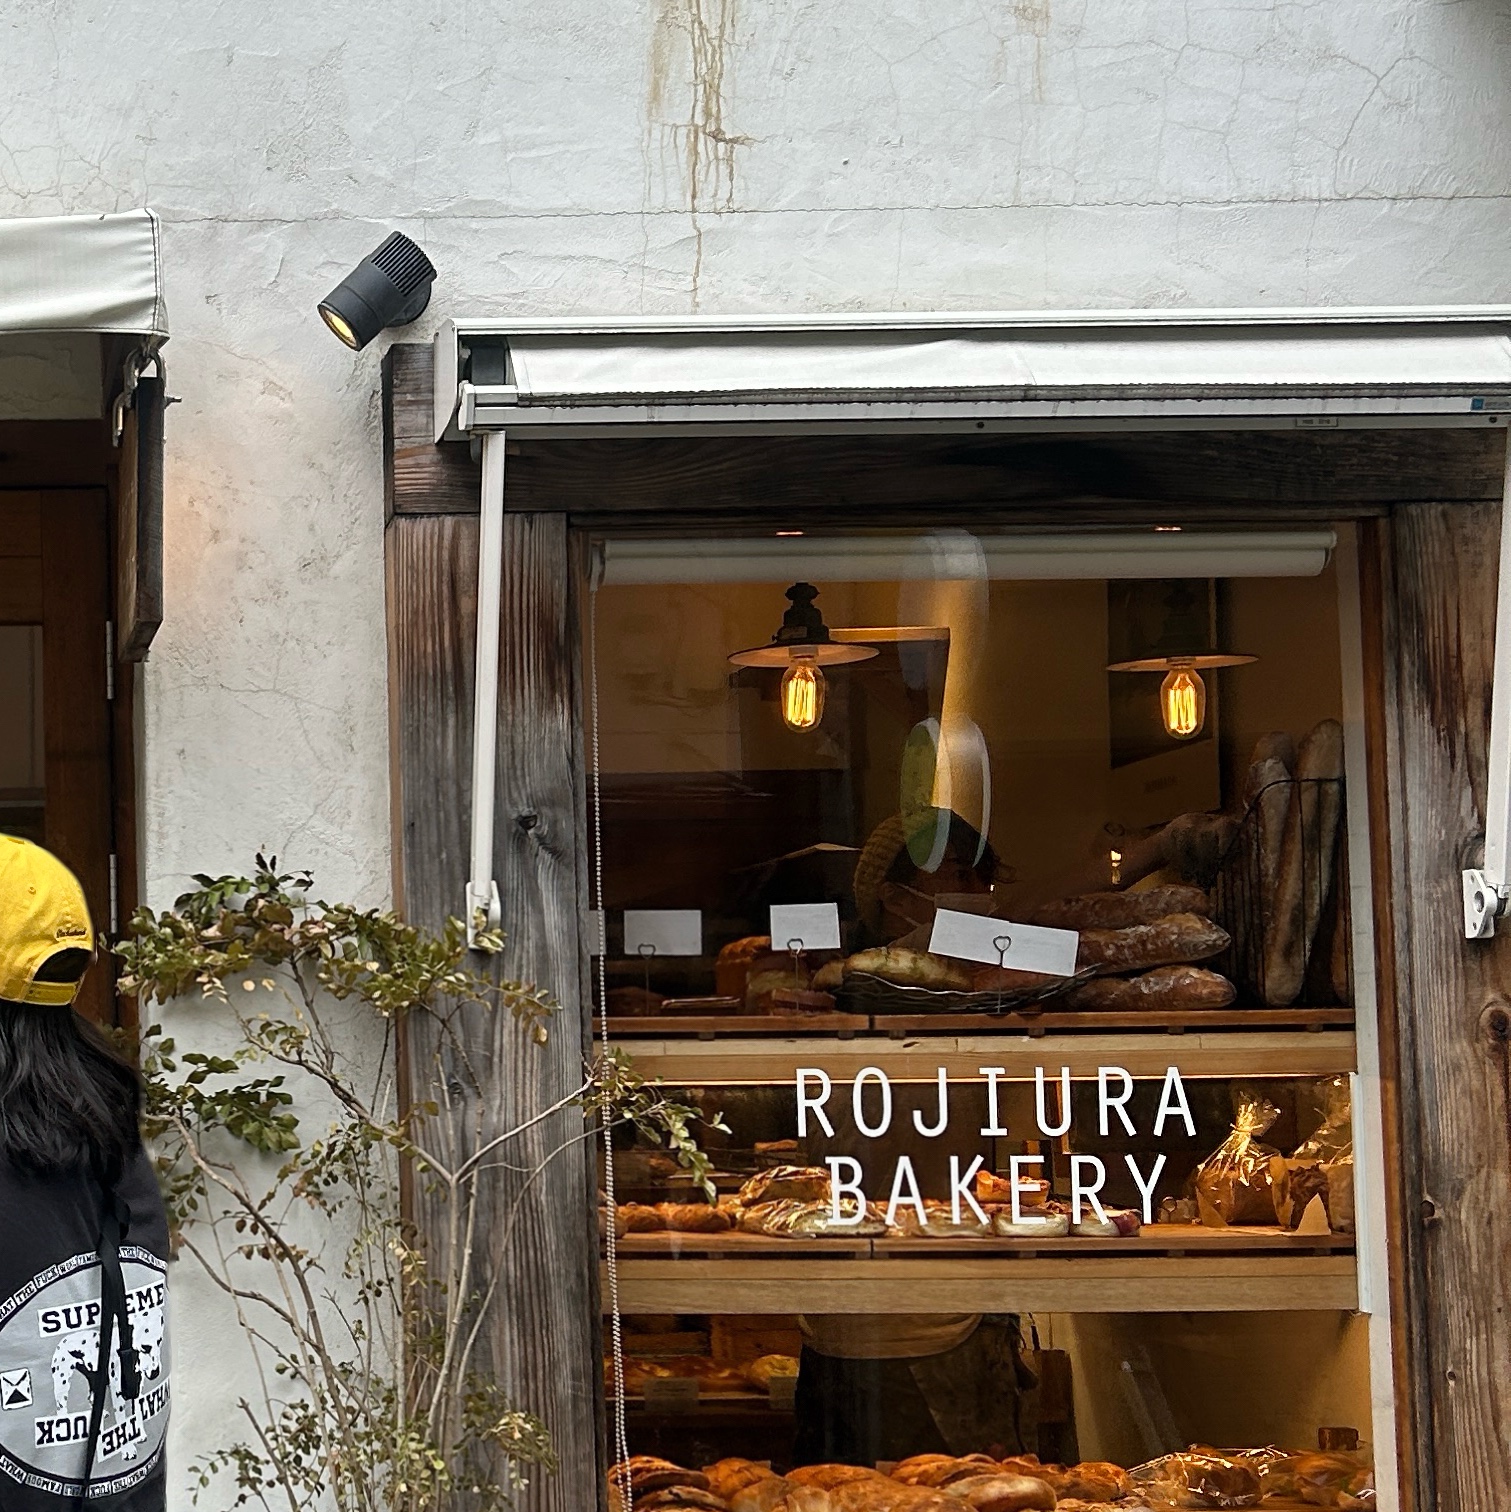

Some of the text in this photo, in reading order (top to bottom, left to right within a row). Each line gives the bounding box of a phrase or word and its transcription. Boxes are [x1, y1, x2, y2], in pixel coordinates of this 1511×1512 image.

[795, 1066, 1197, 1138] ROJIURA
[824, 1154, 1167, 1226] BAKERY
[41, 1283, 165, 1334] SUPEME
[36, 1415, 89, 1446] UCK
[101, 1416, 141, 1457] THE
